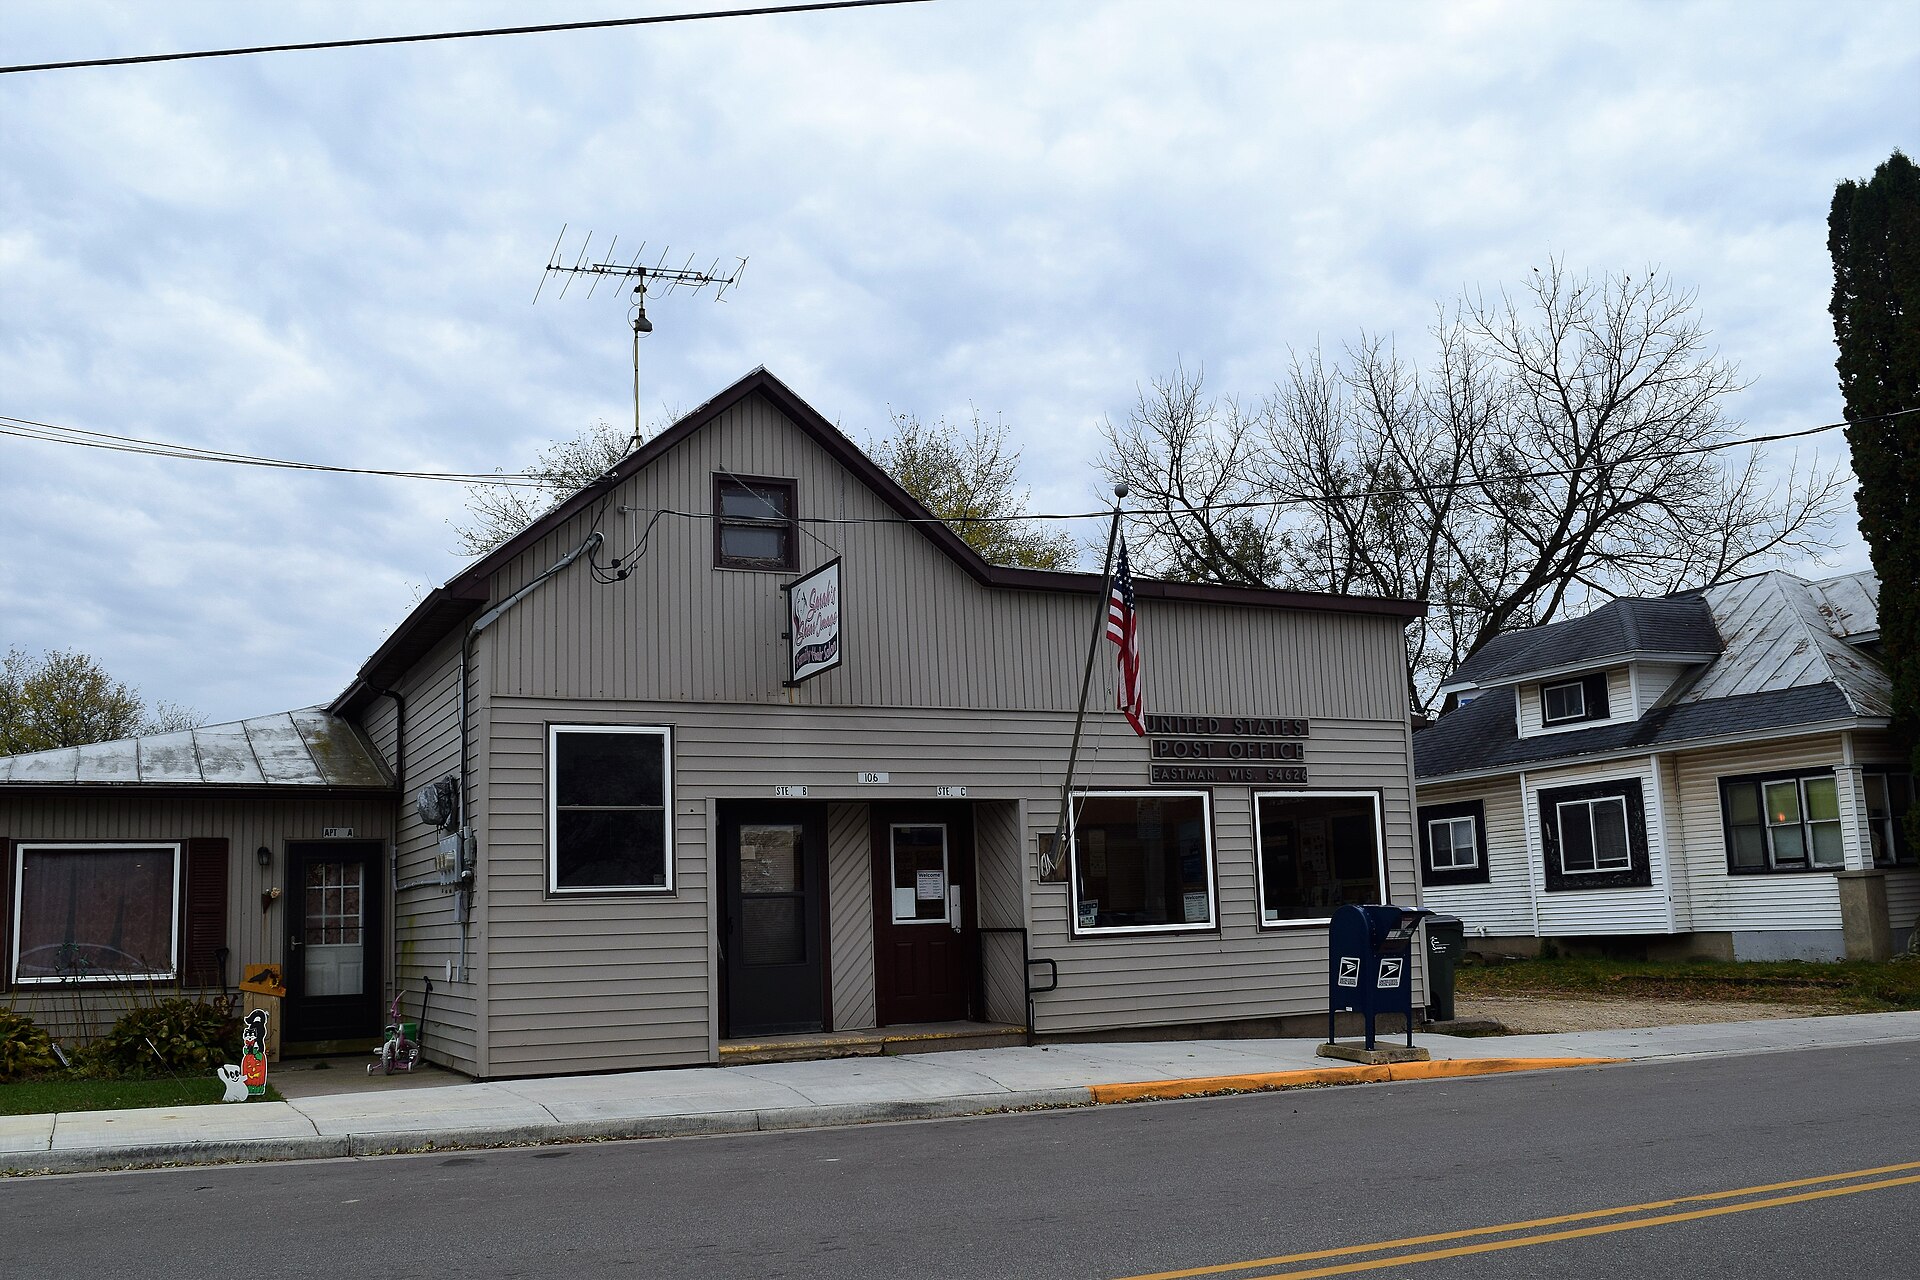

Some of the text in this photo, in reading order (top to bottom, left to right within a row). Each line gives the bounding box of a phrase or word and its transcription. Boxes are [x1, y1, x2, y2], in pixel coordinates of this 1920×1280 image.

[1146, 716, 1303, 735] UNITED STATES
[1159, 741, 1304, 759] POST OFFICE
[864, 773, 879, 782] 106
[1229, 769, 1258, 780] WIS.
[1267, 769, 1307, 781] 54626
[802, 787, 807, 796] B
[960, 787, 966, 796] C
[324, 829, 352, 837] APT A
